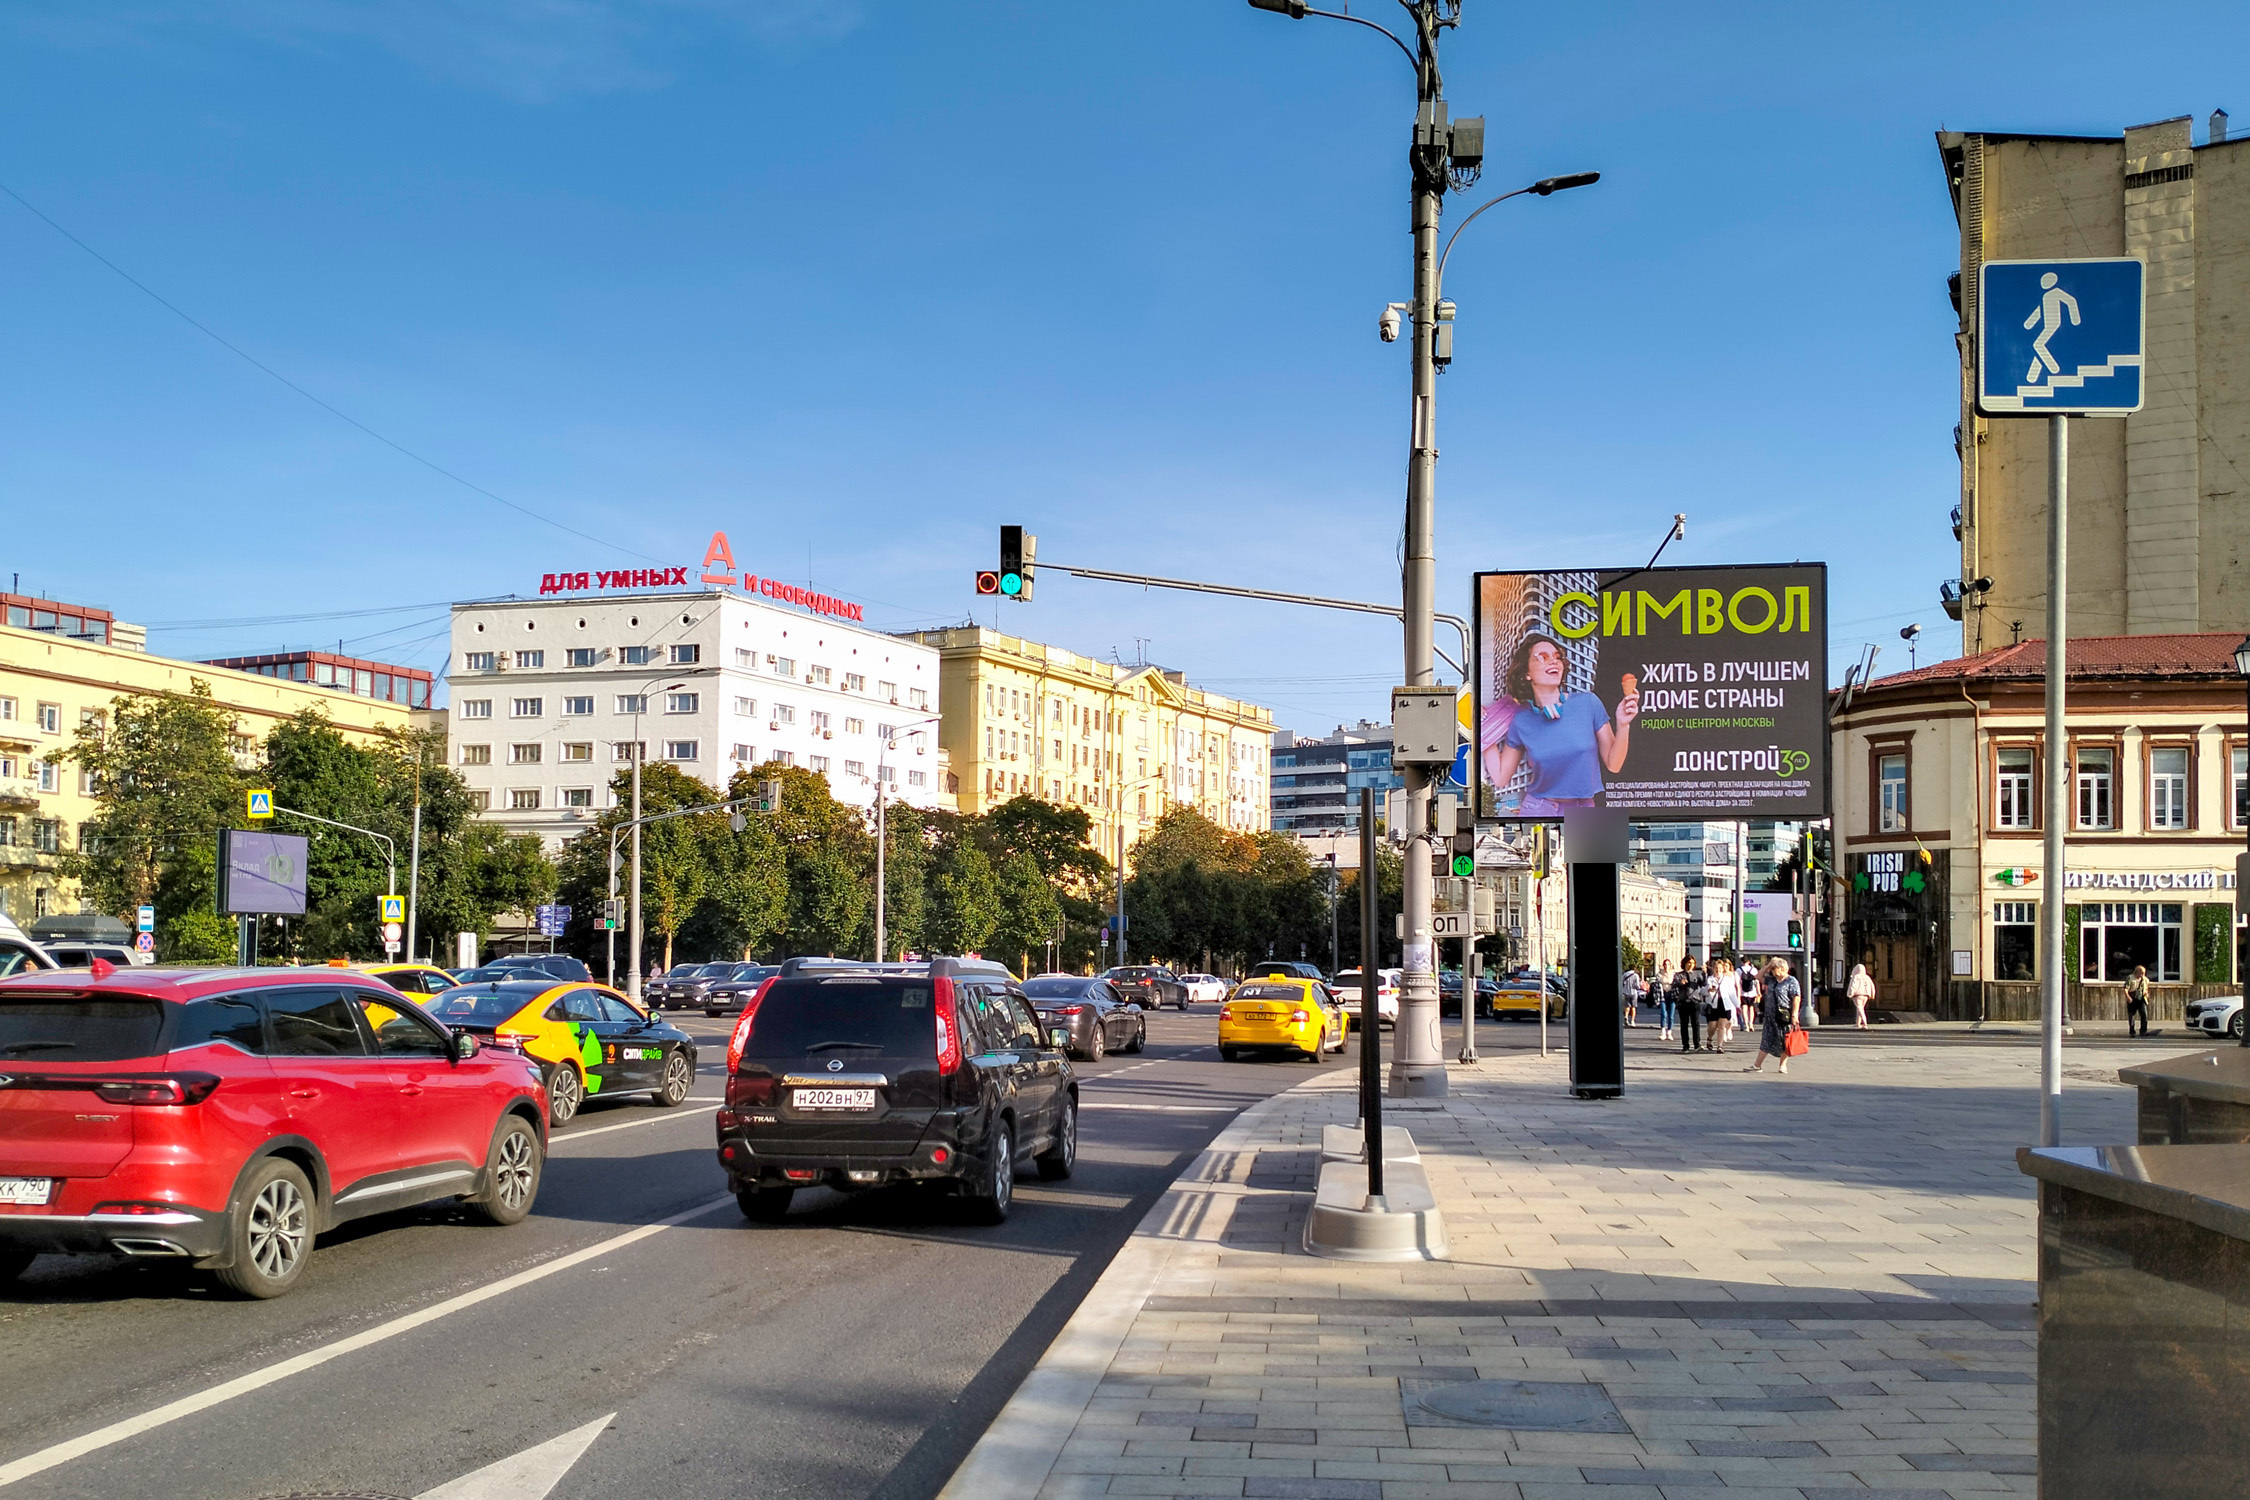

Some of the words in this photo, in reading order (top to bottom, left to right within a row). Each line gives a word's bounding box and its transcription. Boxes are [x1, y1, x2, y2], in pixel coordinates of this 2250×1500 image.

[540, 572, 590, 594] ДЛЯ
[595, 567, 688, 589] УМНЫХ
[744, 573, 758, 593] И
[761, 578, 864, 622] СВОБОДНЫХ
[1551, 586, 1810, 639] СИМВОЛ
[1641, 663, 1698, 683] ЖИТЬ
[1703, 662, 1716, 682] В
[1720, 660, 1810, 682] ЛУЧШЕМ
[1641, 690, 1699, 712] ДОМЕ
[1704, 688, 1784, 709] СТРАНЫ
[1641, 719, 1675, 730] РЯДОМ
[1677, 718, 1684, 729] С
[1685, 718, 1730, 730] ЦЕНТРОМ
[1732, 717, 1775, 728] МОСКВЫ
[1673, 745, 1779, 772] ДОНСТРОЙ
[265, 854, 293, 884] 19
[1867, 853, 1904, 873] IRISH
[1873, 873, 1899, 892] PUB
[2064, 869, 2219, 891] ИРЛАНДСКИЙ
[1433, 917, 1458, 932] ОП
[856, 1091, 869, 1101] 97
[75, 1114, 120, 1122] CHERY
[744, 1115, 778, 1123] X-TRAIL
[22, 1178, 46, 1192] 790
